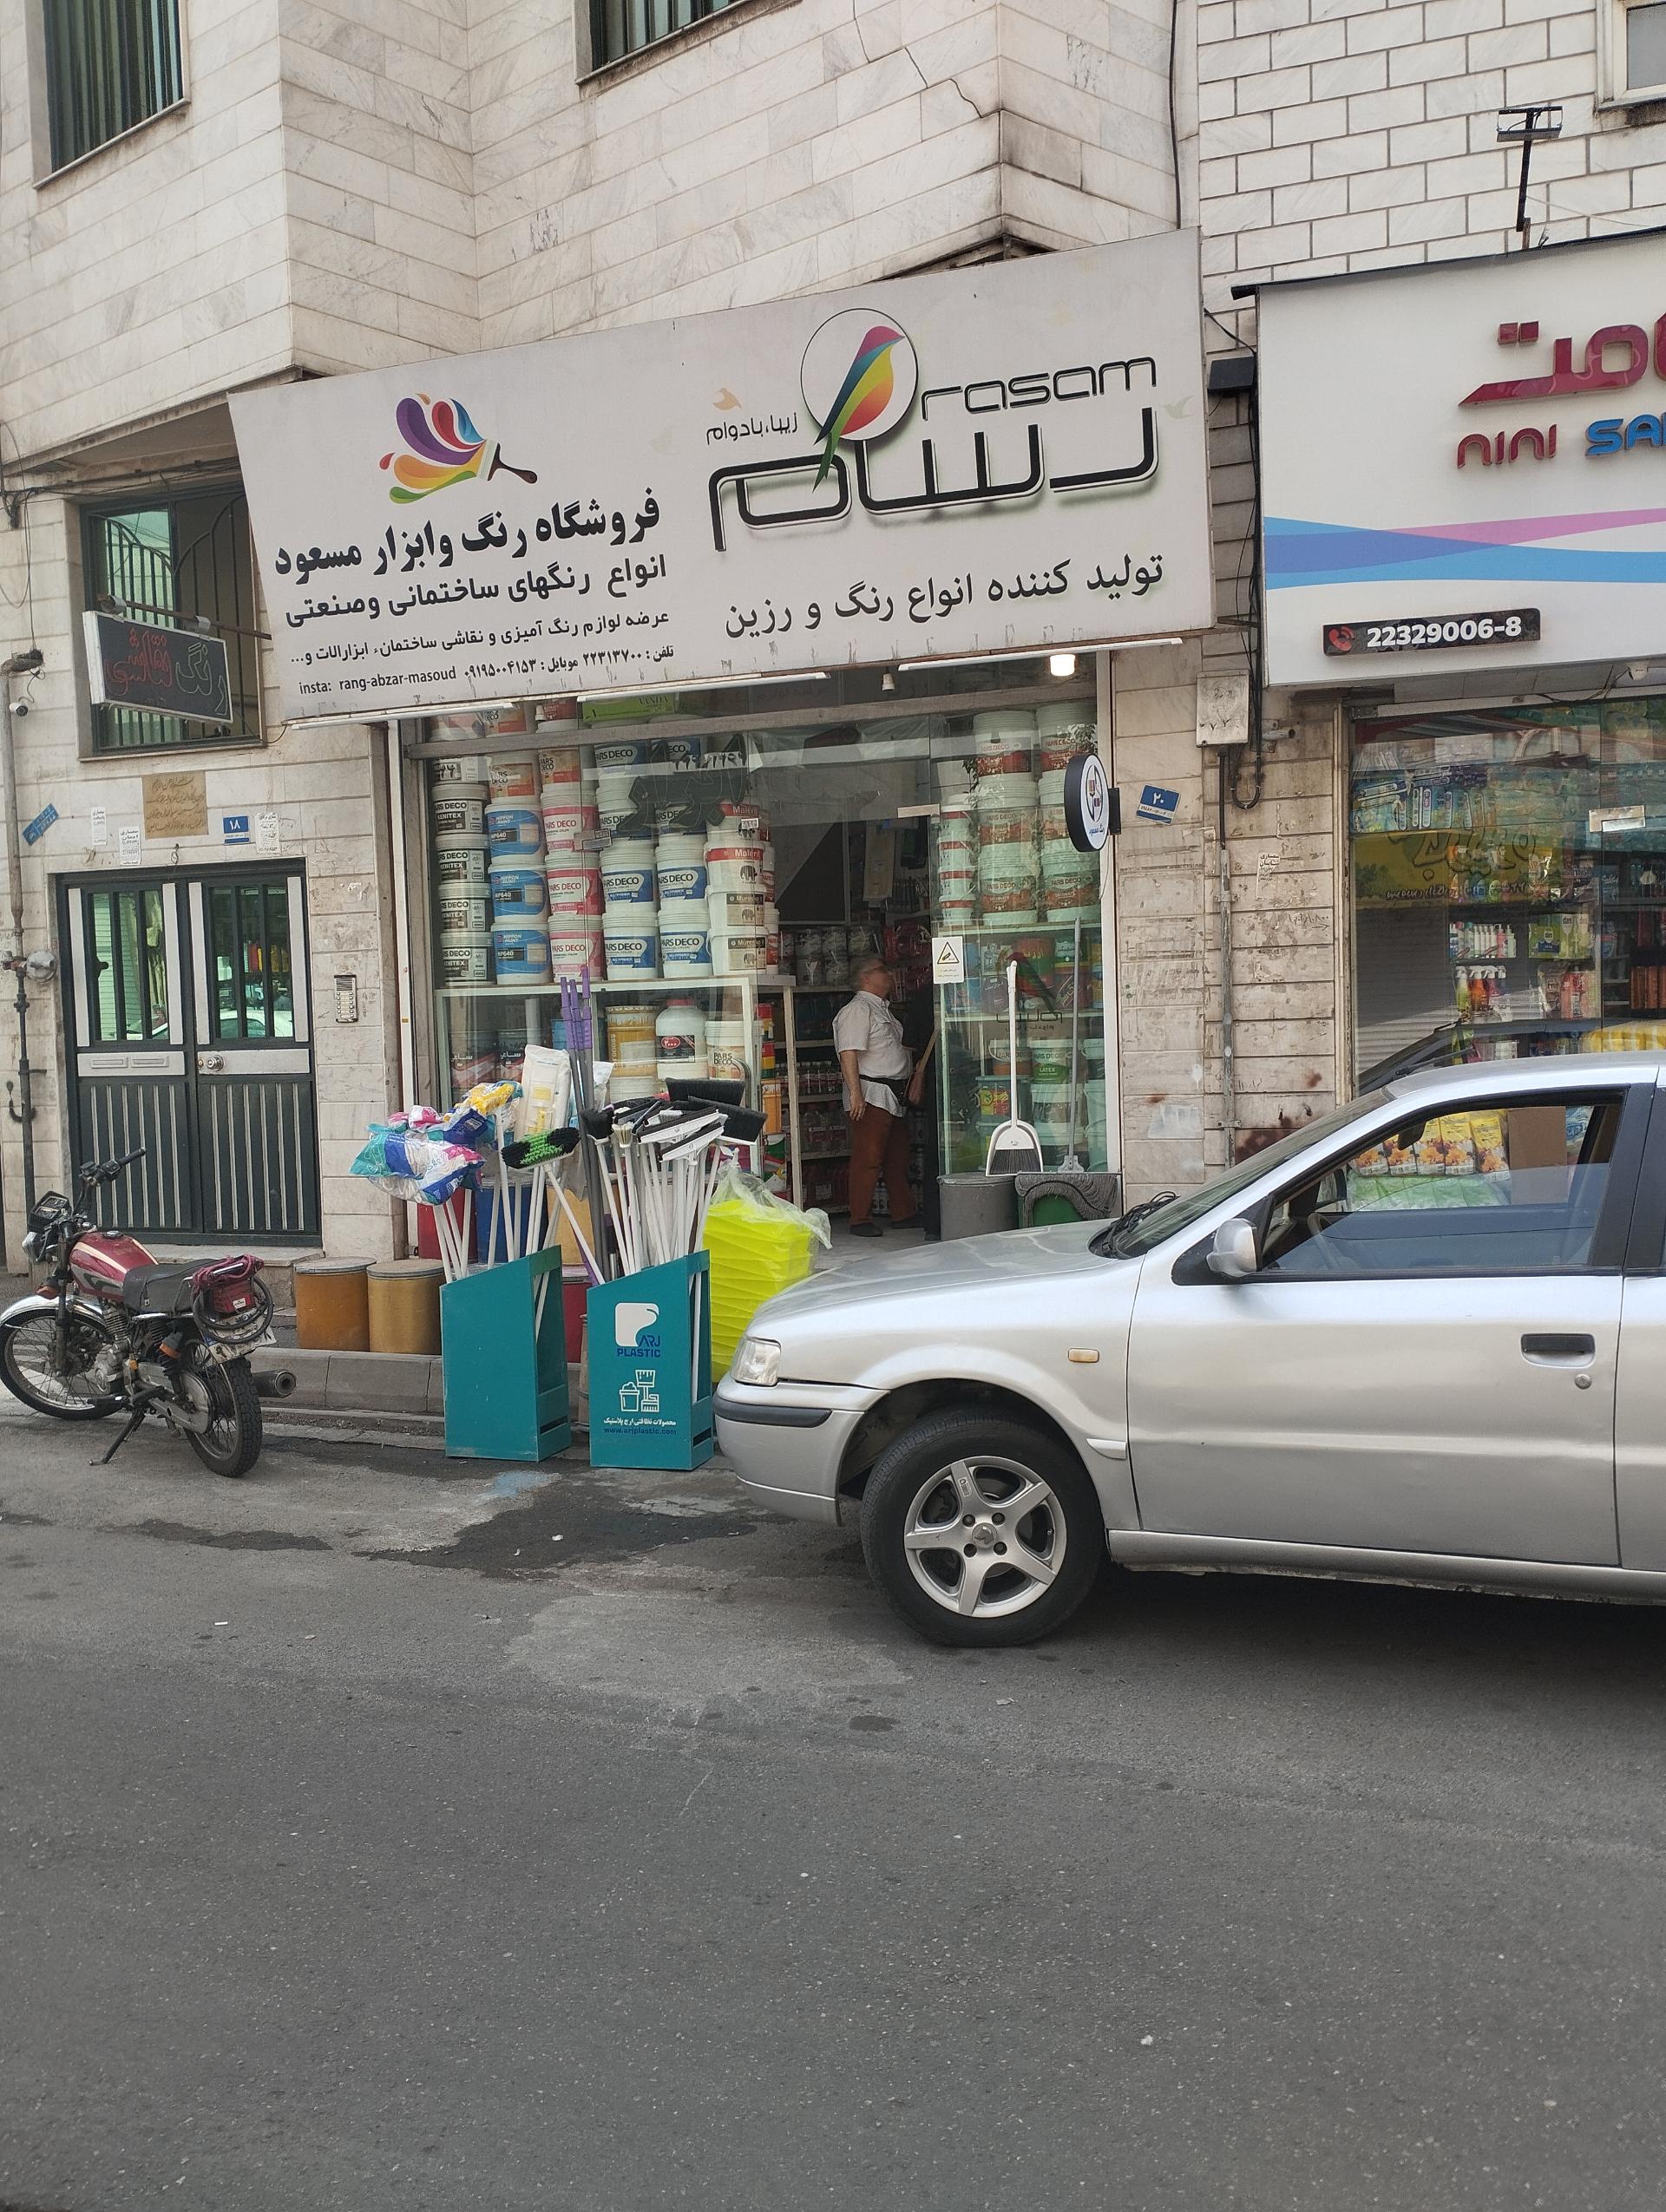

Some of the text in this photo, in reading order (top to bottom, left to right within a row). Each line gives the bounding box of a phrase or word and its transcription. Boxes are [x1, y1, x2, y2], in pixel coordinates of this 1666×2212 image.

[922, 357, 1157, 420] rasam
[708, 407, 1158, 552] رسام
[535, 487, 660, 546] فروشگاه
[462, 510, 528, 559] رنگ
[275, 545, 362, 586] مسعود
[607, 553, 666, 599] انواع
[508, 561, 591, 604] رنگهای
[388, 577, 500, 617] ساختمانی
[725, 553, 1163, 638] تولید کننده انواع رنگ و رزین
[548, 618, 579, 637] رنگ
[583, 613, 621, 637] لوازم
[626, 611, 669, 628] عرضه
[442, 629, 485, 651] نقاشی
[489, 634, 496, 646] و
[501, 620, 542, 645] آمیزی
[1367, 616, 1522, 649] 22329006-8
[582, 649, 641, 667] ۲۲۳۱۳۷۰۰
[298, 666, 457, 695] insta: rang-abzar-masoud
[609, 749, 633, 758] DECO
[615, 876, 640, 885] DECO
[670, 874, 693, 882] DECO
[618, 942, 642, 951] DECO
[675, 938, 699, 946] DECO
[617, 1347, 660, 1358] PLASTIC
